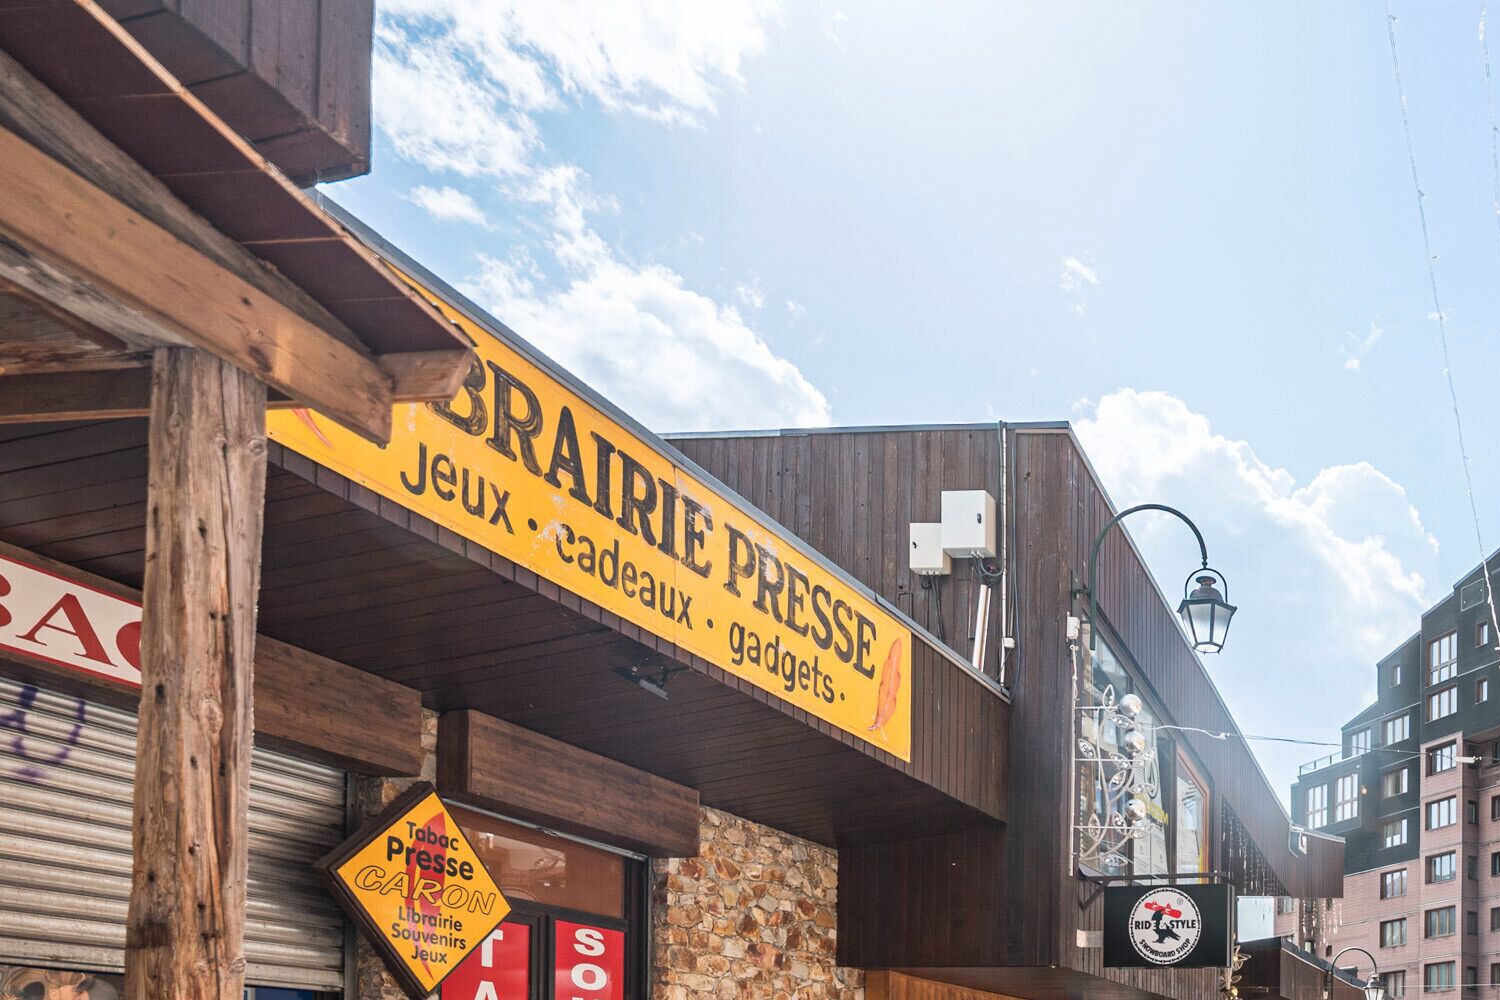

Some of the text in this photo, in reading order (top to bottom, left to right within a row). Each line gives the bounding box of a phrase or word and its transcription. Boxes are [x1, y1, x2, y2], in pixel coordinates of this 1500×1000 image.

[400, 442, 835, 706] Jeux cadeaux gadgets
[724, 521, 877, 680] PRESSE
[406, 820, 459, 851] Tabac
[386, 835, 474, 881] Presse
[354, 865, 497, 916] CARON
[398, 905, 463, 932] Librairie
[1169, 919, 1197, 929] STYLE
[391, 922, 466, 950] Souvenirs
[1139, 938, 1191, 958] SNOWBOARD SHOP
[411, 945, 447, 964] Jeux
